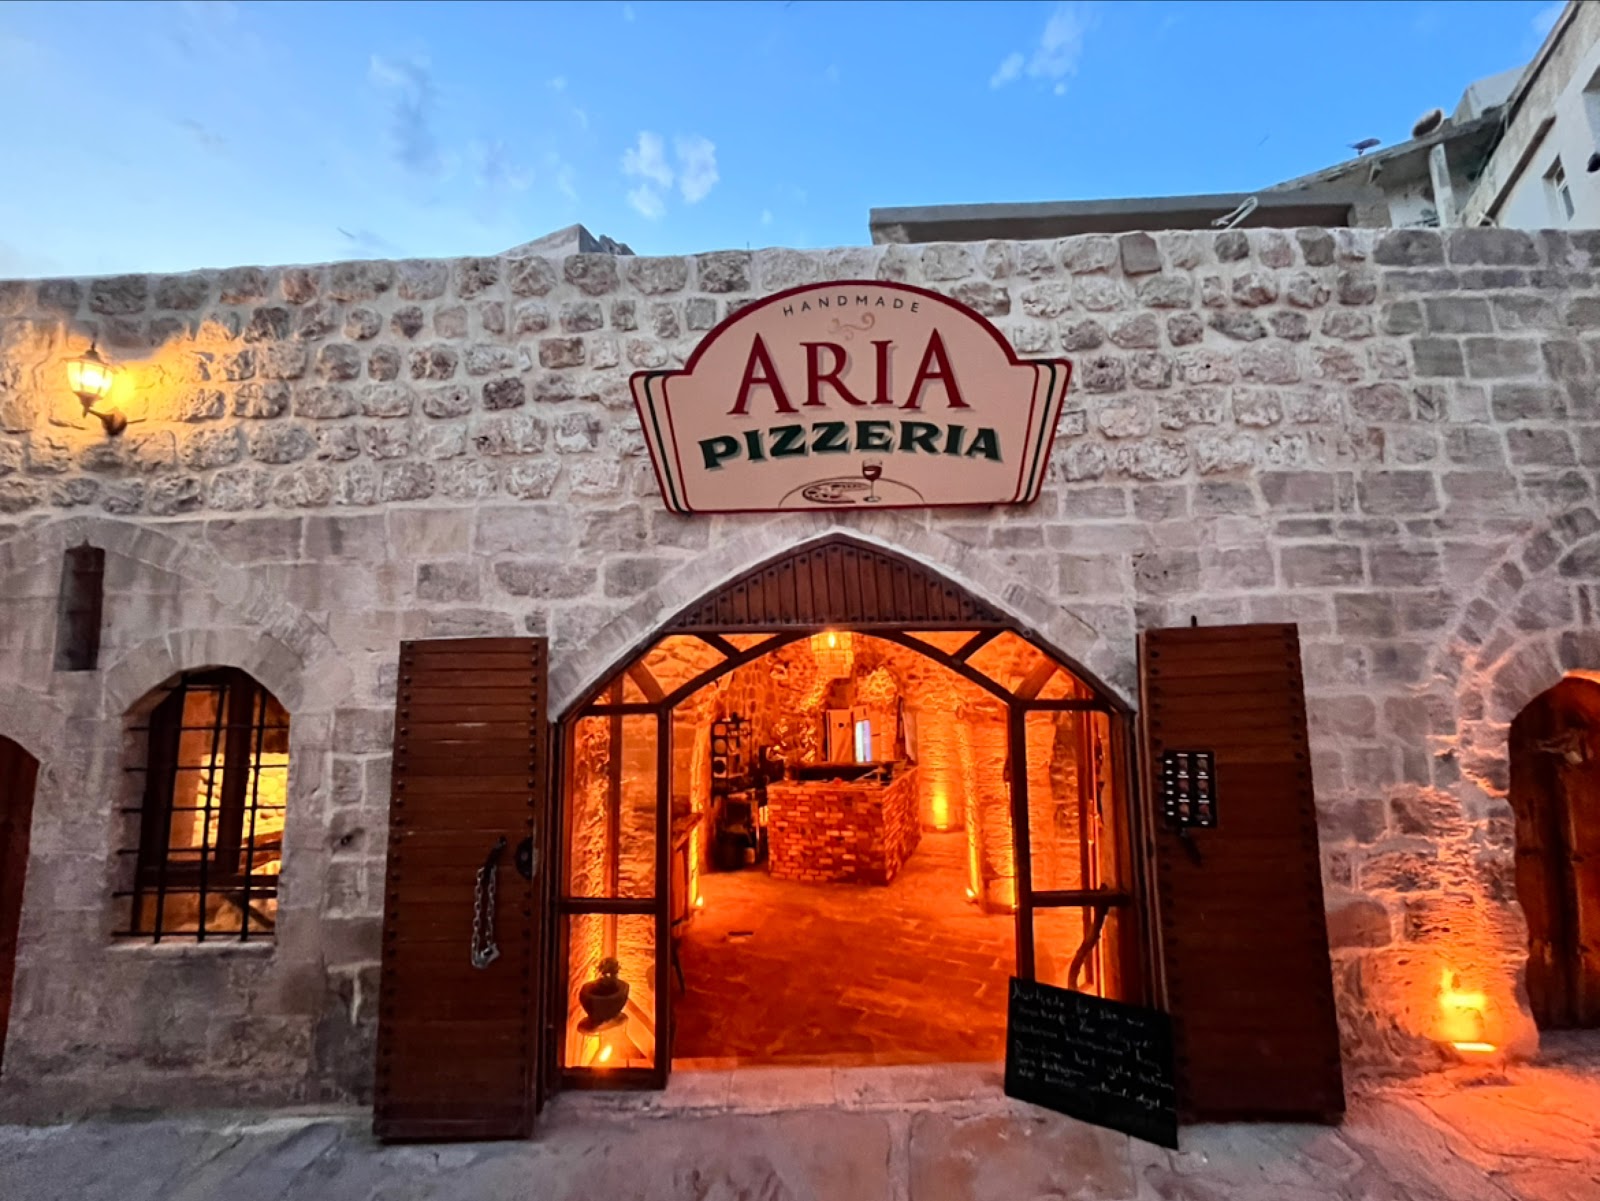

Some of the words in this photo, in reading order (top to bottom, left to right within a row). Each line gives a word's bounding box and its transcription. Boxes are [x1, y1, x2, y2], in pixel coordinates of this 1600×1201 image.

[783, 295, 920, 316] HANDMADE
[726, 327, 970, 415] ARIA
[698, 420, 1002, 469] PIZZERIA
